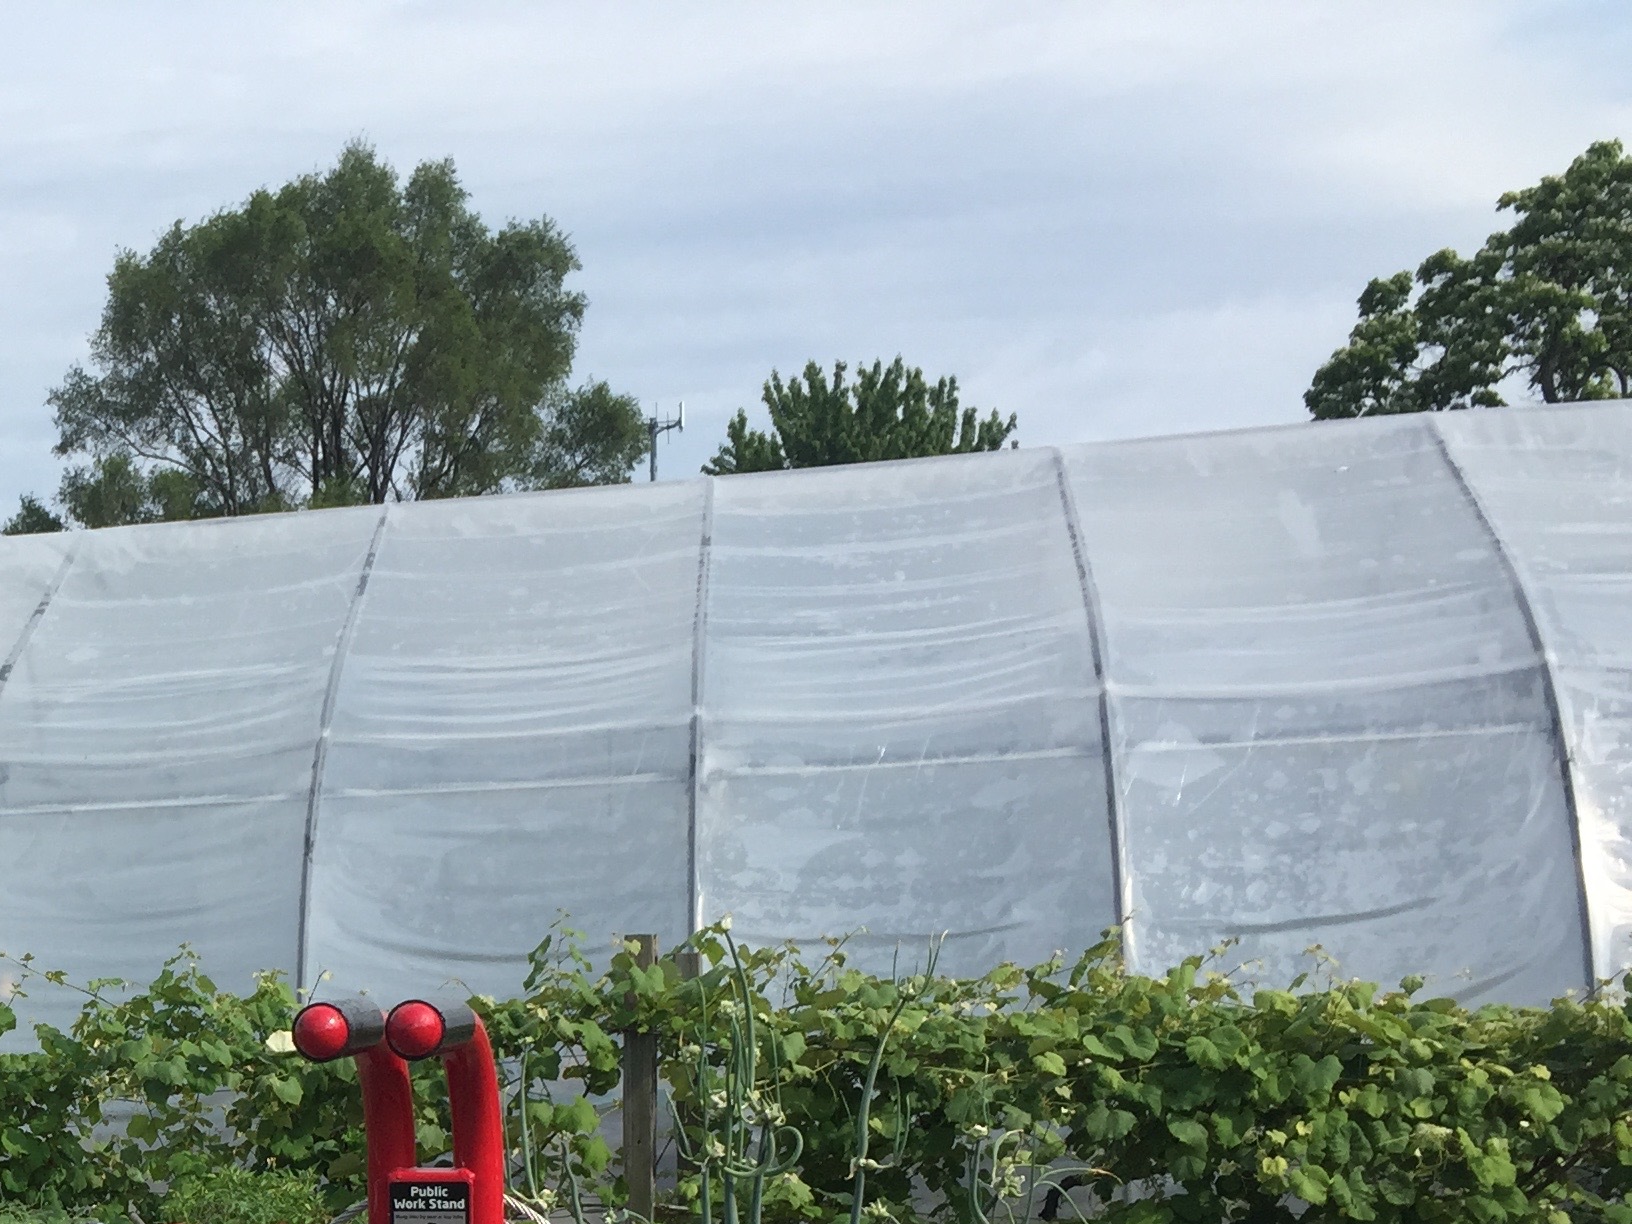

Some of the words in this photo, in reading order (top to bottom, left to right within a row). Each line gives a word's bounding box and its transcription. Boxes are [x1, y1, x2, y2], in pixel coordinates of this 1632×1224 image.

[410, 1186, 449, 1197] Public
[393, 1198, 426, 1210] Work
[428, 1198, 465, 1210] Stand
